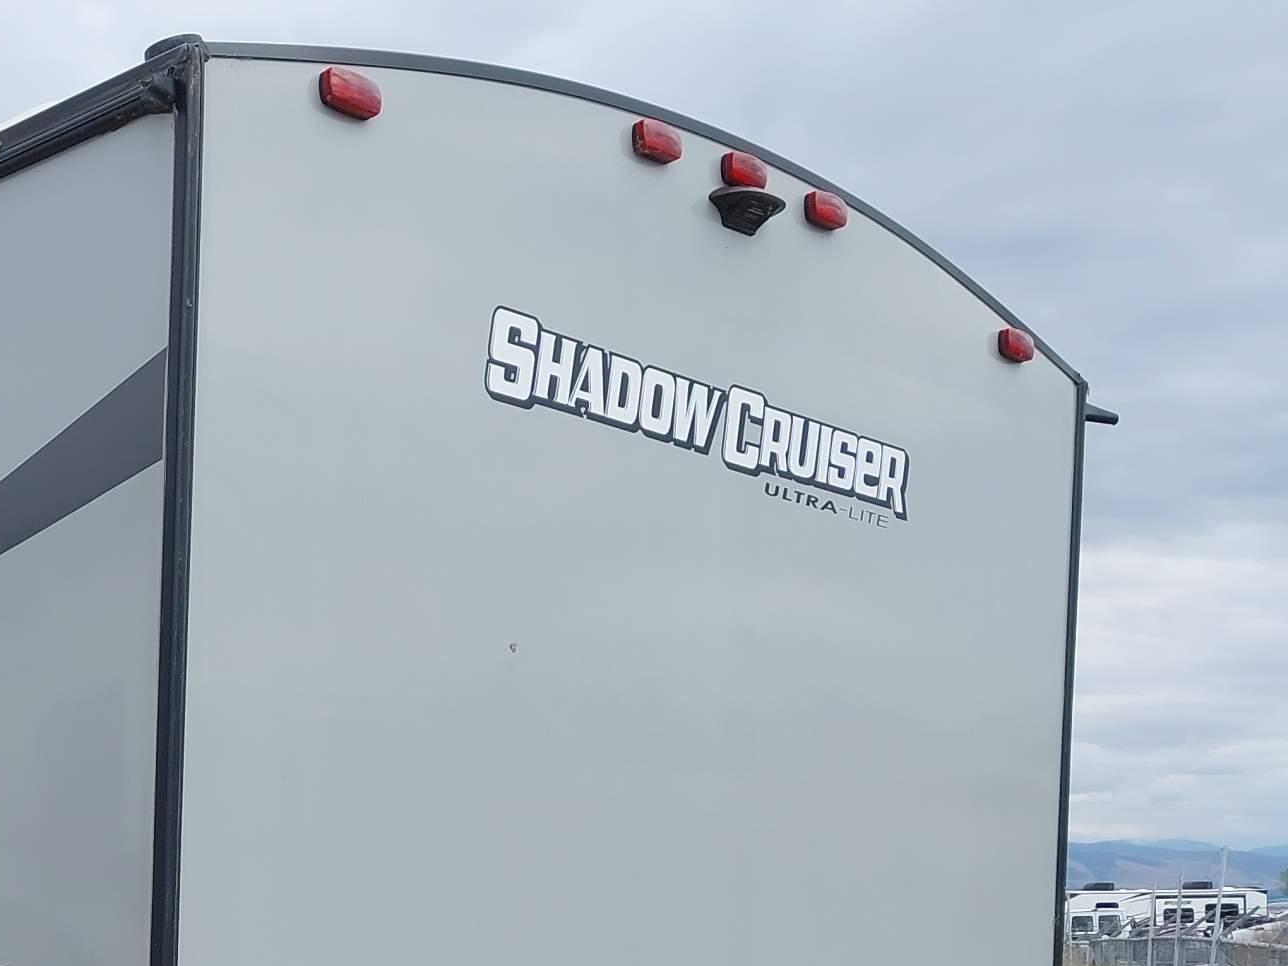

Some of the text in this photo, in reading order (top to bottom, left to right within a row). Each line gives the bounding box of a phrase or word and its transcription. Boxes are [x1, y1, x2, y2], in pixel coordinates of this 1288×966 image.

[485, 305, 909, 521] SHADOW CRUISER
[764, 482, 889, 528] ULTRA-LITE
